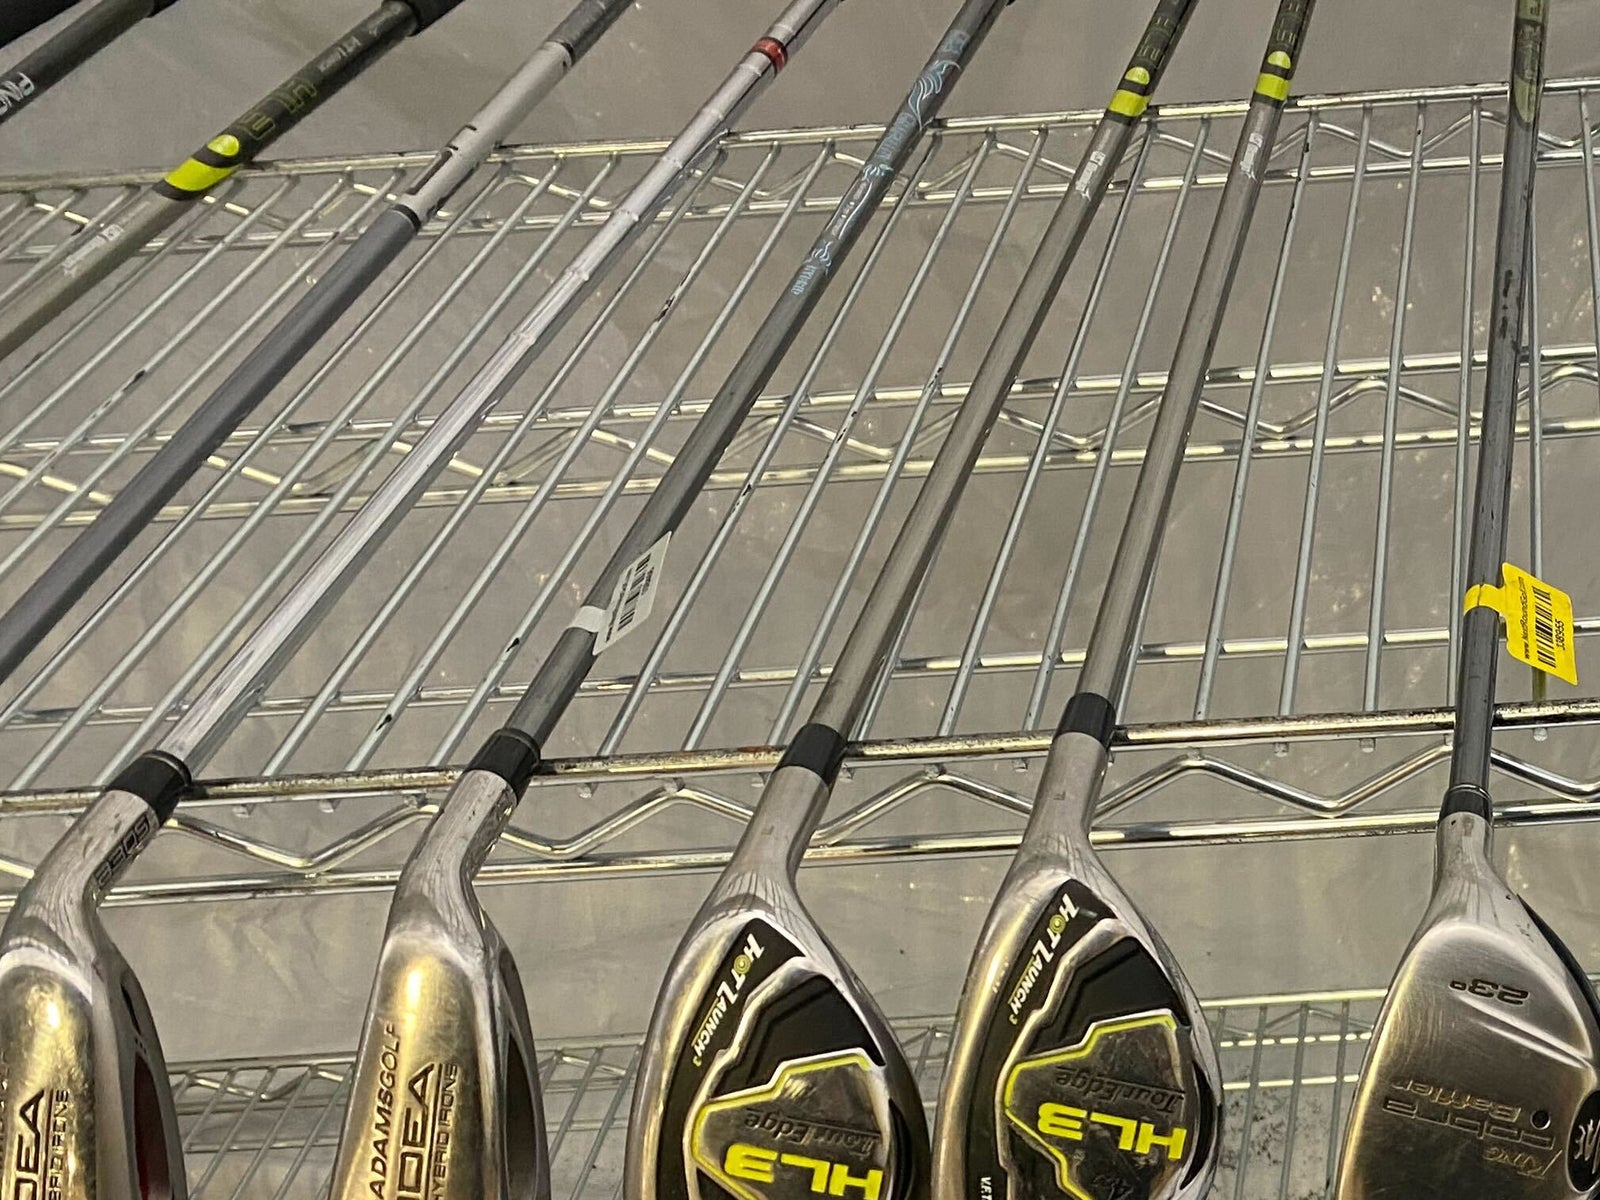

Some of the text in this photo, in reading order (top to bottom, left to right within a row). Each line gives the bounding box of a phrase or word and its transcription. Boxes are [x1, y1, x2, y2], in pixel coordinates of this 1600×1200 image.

[1046, 893, 1080, 950] HOT
[731, 933, 765, 991] HOT
[1390, 1078, 1522, 1124] Baffler
[1036, 1101, 1187, 1161] HL3
